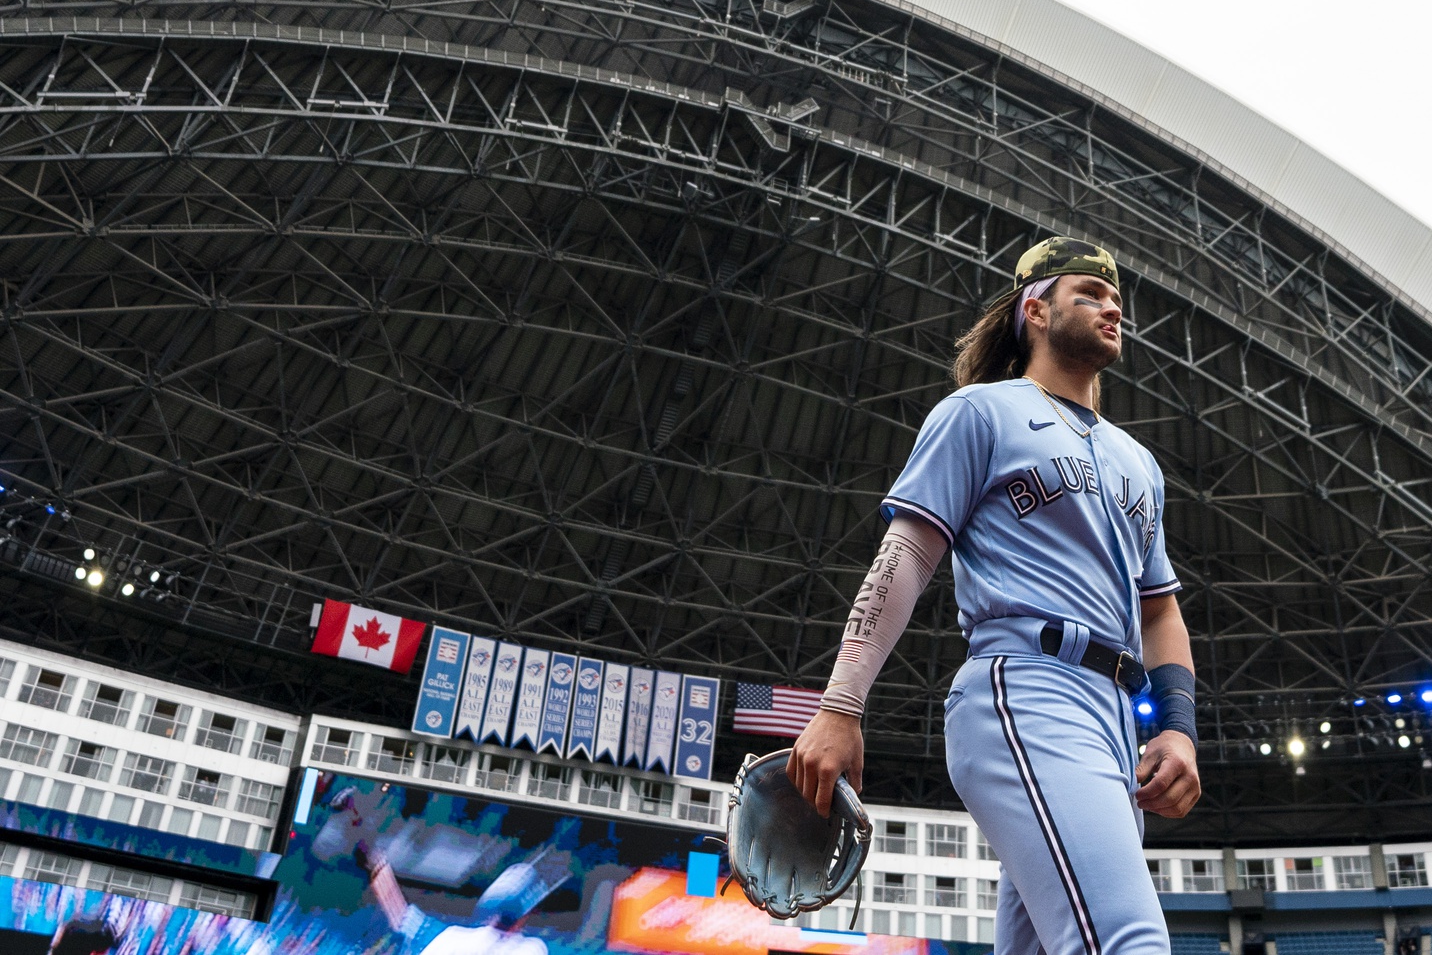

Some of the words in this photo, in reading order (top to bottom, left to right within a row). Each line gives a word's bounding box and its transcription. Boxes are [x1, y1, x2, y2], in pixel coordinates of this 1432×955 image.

[1004, 456, 1100, 520] BLUE
[880, 551, 902, 584] HOME
[875, 585, 889, 603] OF
[864, 606, 883, 630] THE
[427, 677, 455, 690] GILLICK
[436, 672, 449, 682] PAT
[467, 671, 487, 689] 1985
[493, 677, 514, 693] 1989
[523, 682, 542, 698] 1991
[549, 687, 569, 703] 1992
[462, 699, 481, 713] EAST
[577, 692, 597, 708] 1993
[603, 696, 623, 712] 2015
[488, 704, 509, 717] EAST
[518, 709, 538, 721] EAST
[631, 700, 649, 717] 2016
[655, 705, 675, 720] 2020
[681, 717, 713, 745] 32
